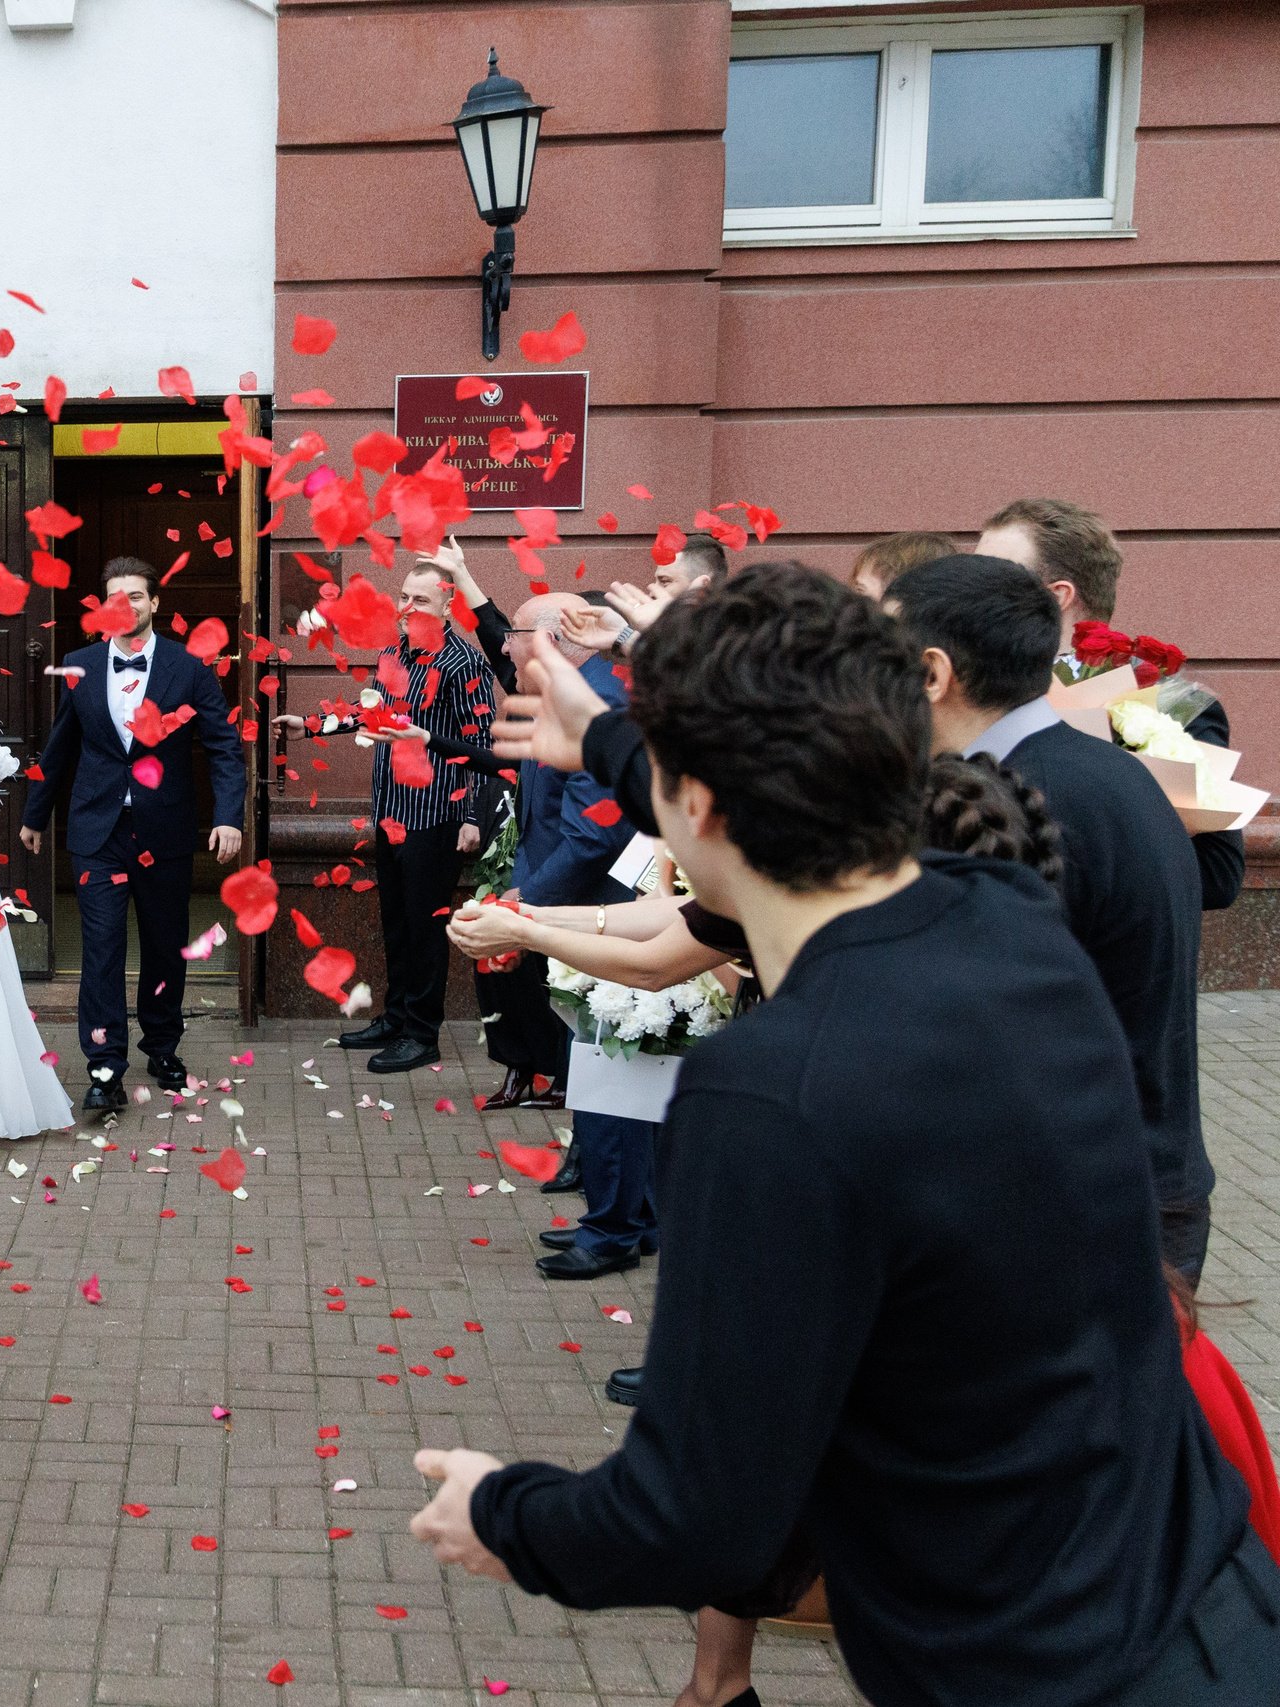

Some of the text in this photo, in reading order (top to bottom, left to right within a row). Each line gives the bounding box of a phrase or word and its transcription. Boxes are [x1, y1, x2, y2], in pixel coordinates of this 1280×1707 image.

[424, 414, 559, 424] ИЖКАР АДМИНИСТРАЫСЬ
[405, 435, 444, 447] КИАГ
